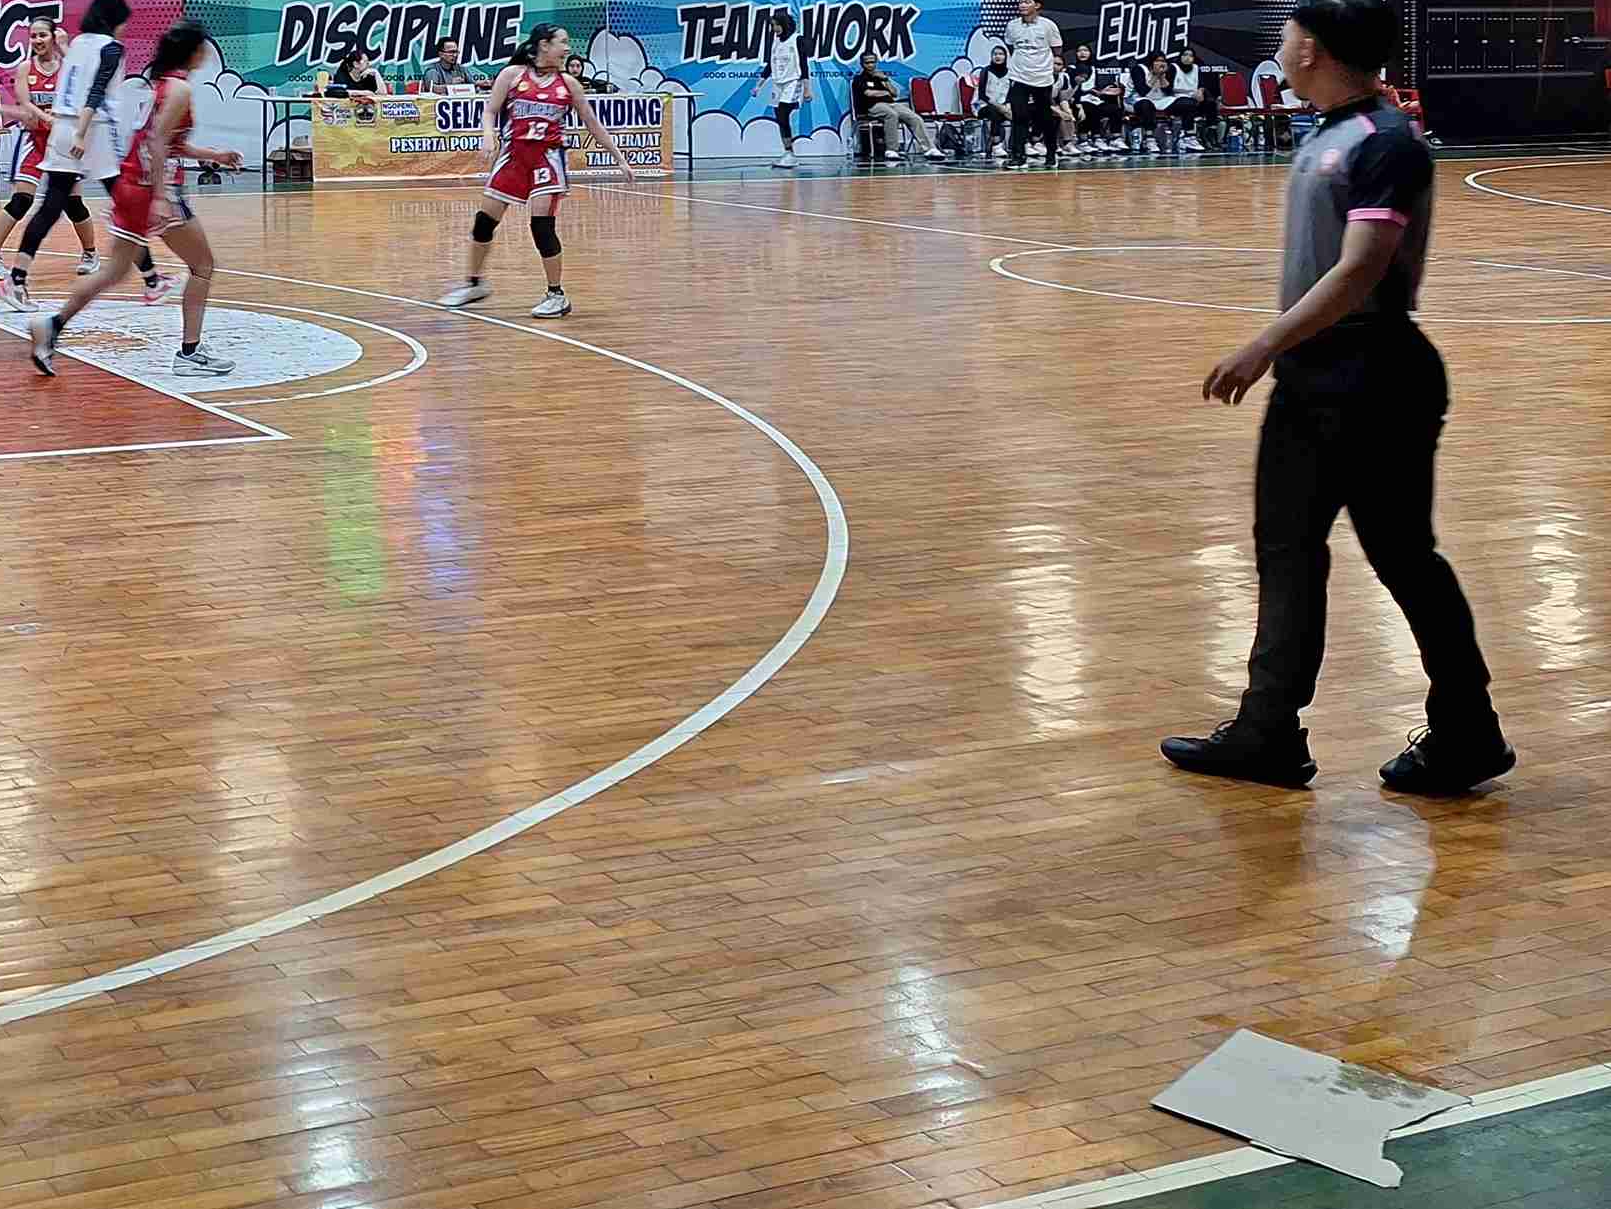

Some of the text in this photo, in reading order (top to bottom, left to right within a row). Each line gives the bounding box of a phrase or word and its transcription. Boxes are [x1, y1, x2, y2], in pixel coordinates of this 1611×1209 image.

[277, 2, 523, 65] DISCIPLINE
[801, 1, 918, 61] WORK
[1096, 1, 1191, 60] ELITE
[391, 137, 447, 153] PESERTA
[628, 152, 661, 165] 2025
